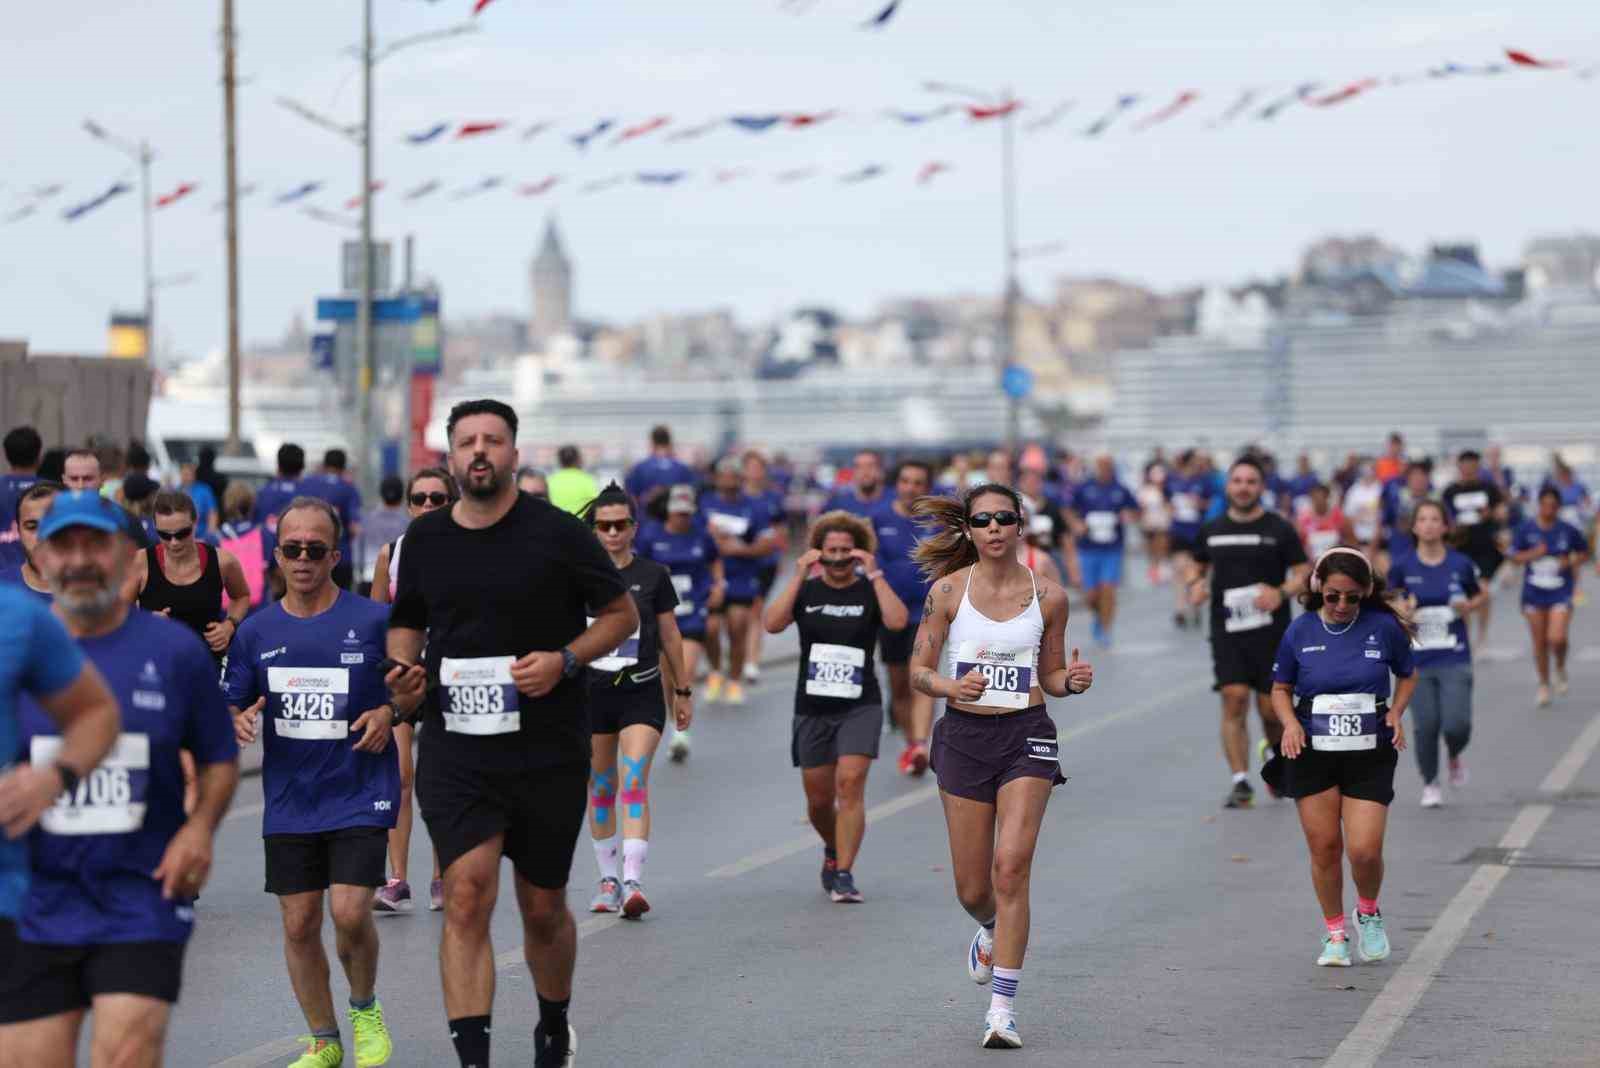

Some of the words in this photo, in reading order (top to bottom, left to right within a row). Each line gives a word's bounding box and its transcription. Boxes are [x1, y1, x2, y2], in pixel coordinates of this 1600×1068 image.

[815, 662, 855, 685] 2032
[281, 693, 334, 720] 3426
[448, 684, 504, 714] 3993
[1328, 714, 1361, 736] 963
[56, 769, 131, 806] 706
